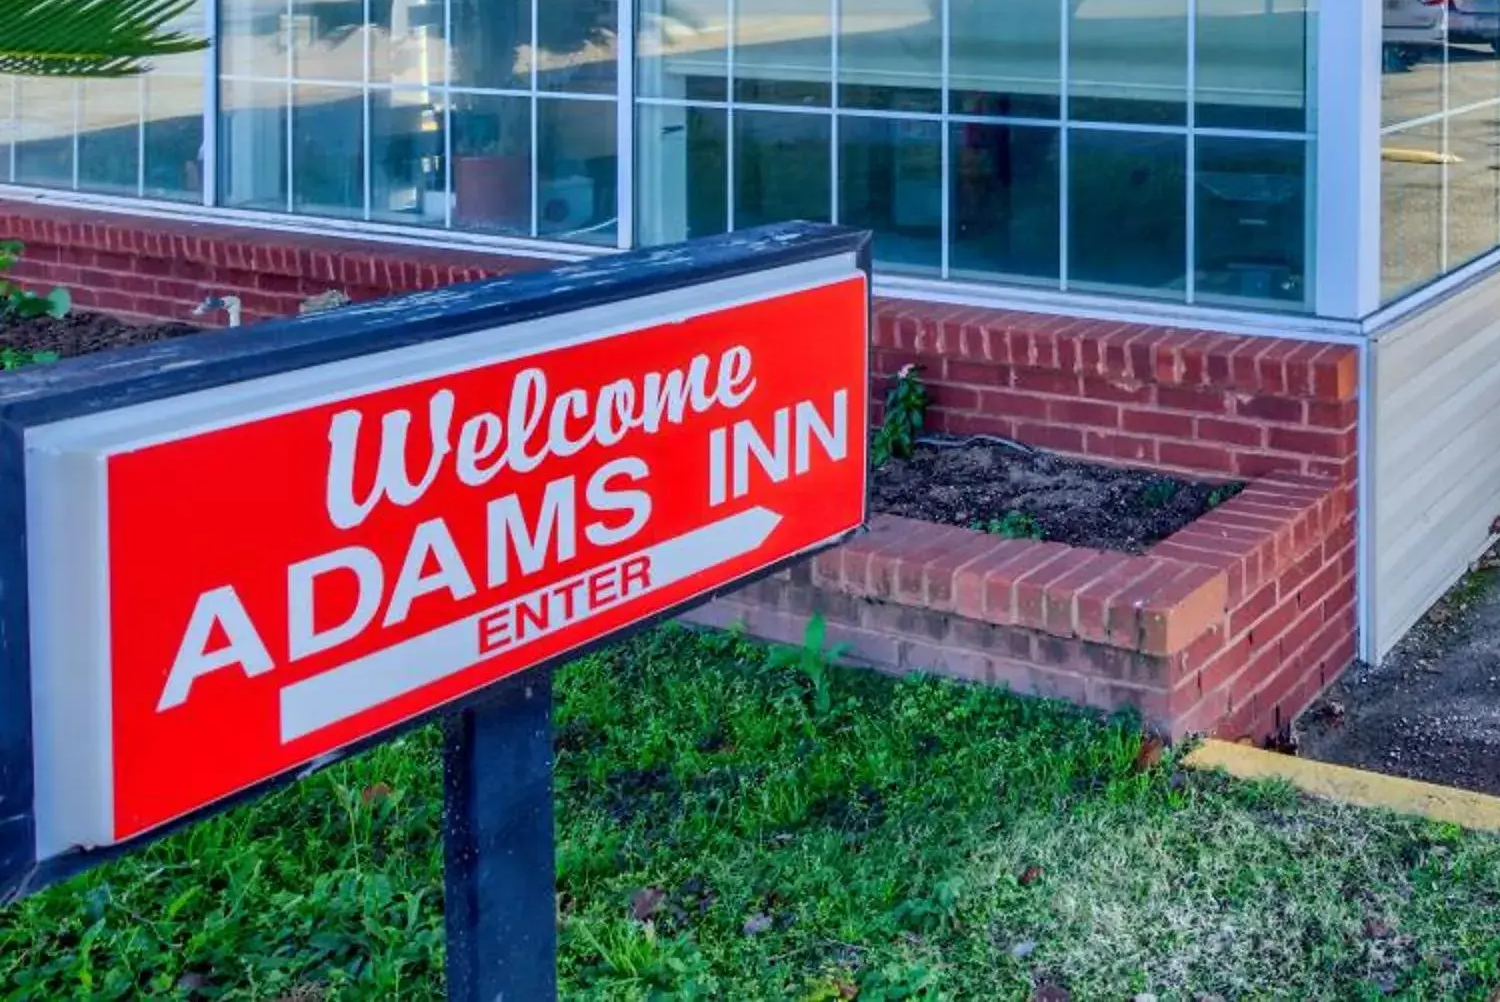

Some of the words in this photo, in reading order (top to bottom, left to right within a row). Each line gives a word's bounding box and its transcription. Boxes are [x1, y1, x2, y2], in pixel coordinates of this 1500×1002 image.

[325, 344, 757, 530] Welcome
[155, 457, 652, 713] ADAMS
[709, 389, 849, 507] INN
[477, 556, 652, 656] ENTER
